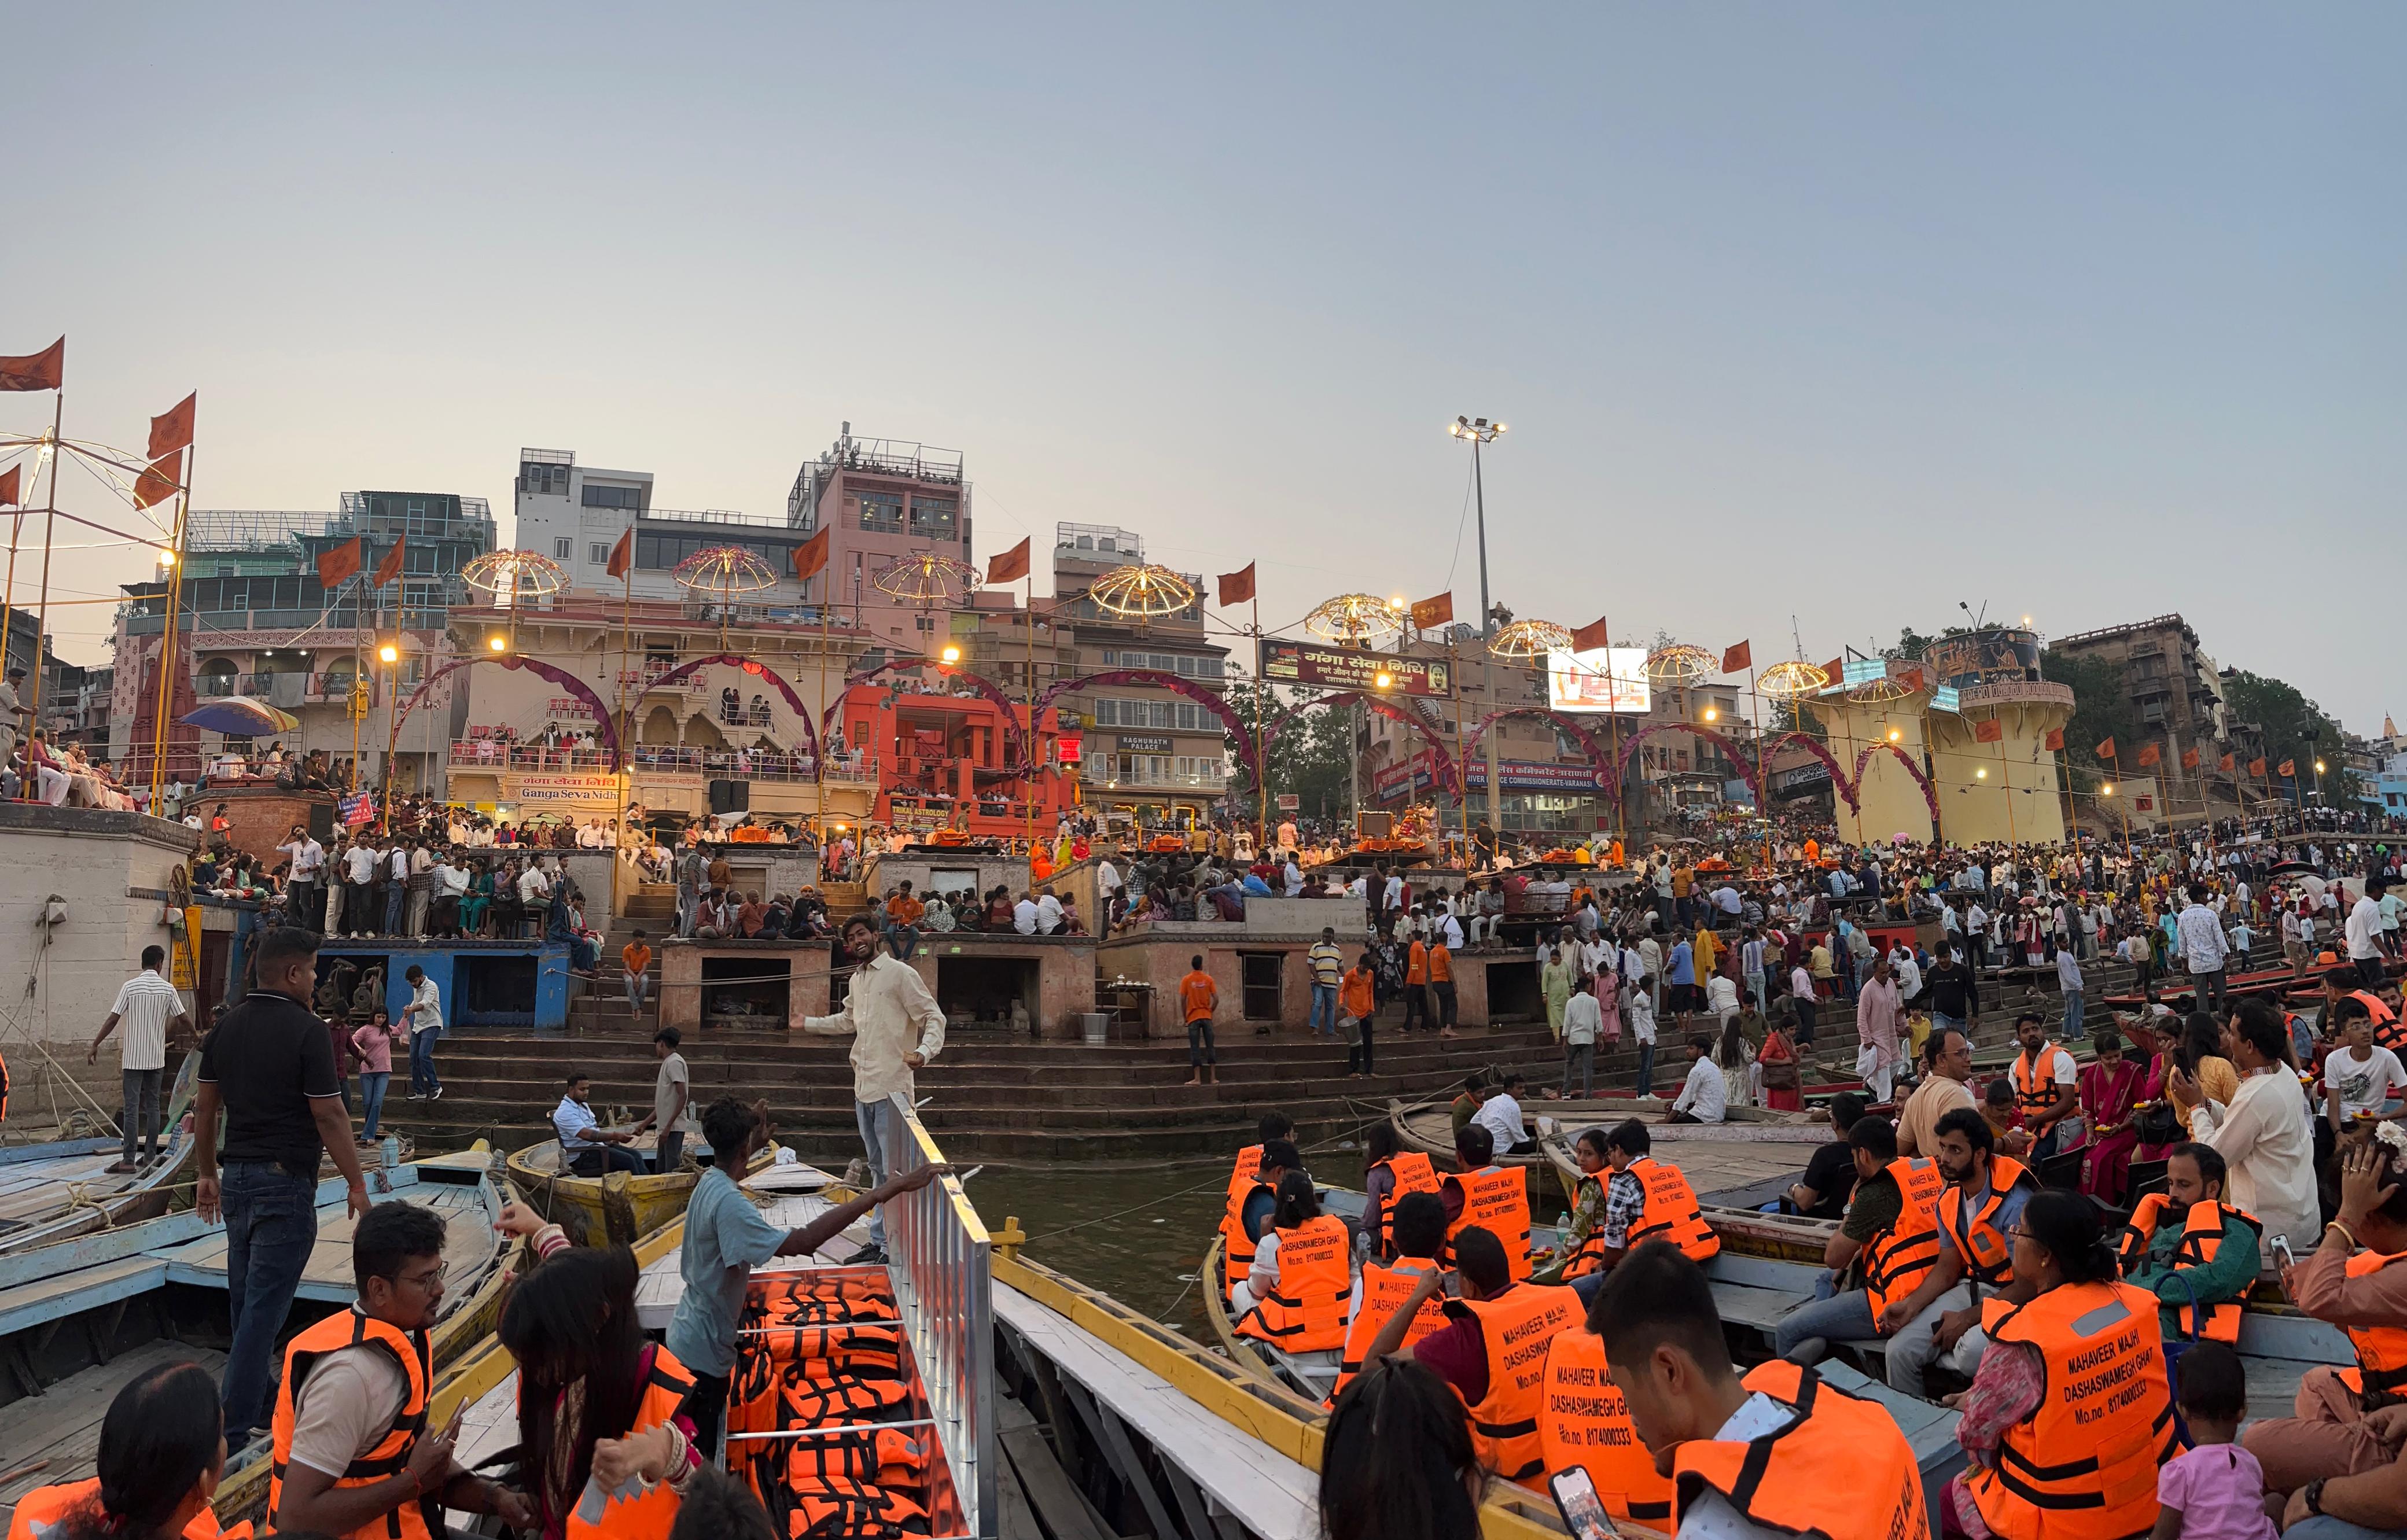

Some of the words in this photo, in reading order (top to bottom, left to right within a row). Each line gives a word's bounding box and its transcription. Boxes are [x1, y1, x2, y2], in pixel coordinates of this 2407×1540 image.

[1304, 651, 1344, 665] गंगा
[1348, 655, 1383, 670] सेवा
[1386, 659, 1425, 675] निधि
[1316, 666, 1331, 674] हमारे
[1333, 667, 1350, 676] जीवन
[1352, 669, 1360, 677] की
[524, 776, 550, 784] गंगा
[554, 777, 581, 785] सेवा
[586, 778, 616, 786] निधि
[1509, 776, 1592, 787] COMMISSIONERATE-VARANASI
[522, 789, 558, 799] Ganga
[561, 790, 590, 799] Seva
[892, 806, 913, 815] TRIKAL
[914, 808, 949, 817] ASTROLOGY
[1474, 1181, 1499, 1193] MAHAVEER
[1501, 1178, 1514, 1188] MAJHI
[1471, 1192, 1510, 1207] DASHASWAMEGH
[1511, 1189, 1521, 1198] GHAT
[1282, 1237, 1326, 1252] DASHASWAMEGH
[1326, 1235, 1339, 1245] GHAT
[1306, 1250, 1333, 1263] 8174000333
[1503, 1316, 1545, 1346] MAHAVEER
[1503, 1334, 1554, 1370] DASHASWAM
[2068, 1342, 2116, 1375] MAHAVEER
[2118, 1328, 2140, 1354] MAJHI
[1557, 1366, 1595, 1387] MAHAVEER
[2064, 1358, 2137, 1402] DASHASWAMEGH
[2136, 1347, 2152, 1370] GHAT
[1551, 1394, 1616, 1417] DASHASWAMEGH
[2075, 1406, 2104, 1425] Mo.no.
[2108, 1379, 2147, 1413] 8174000333
[1587, 1427, 1631, 1446] 8174000333
